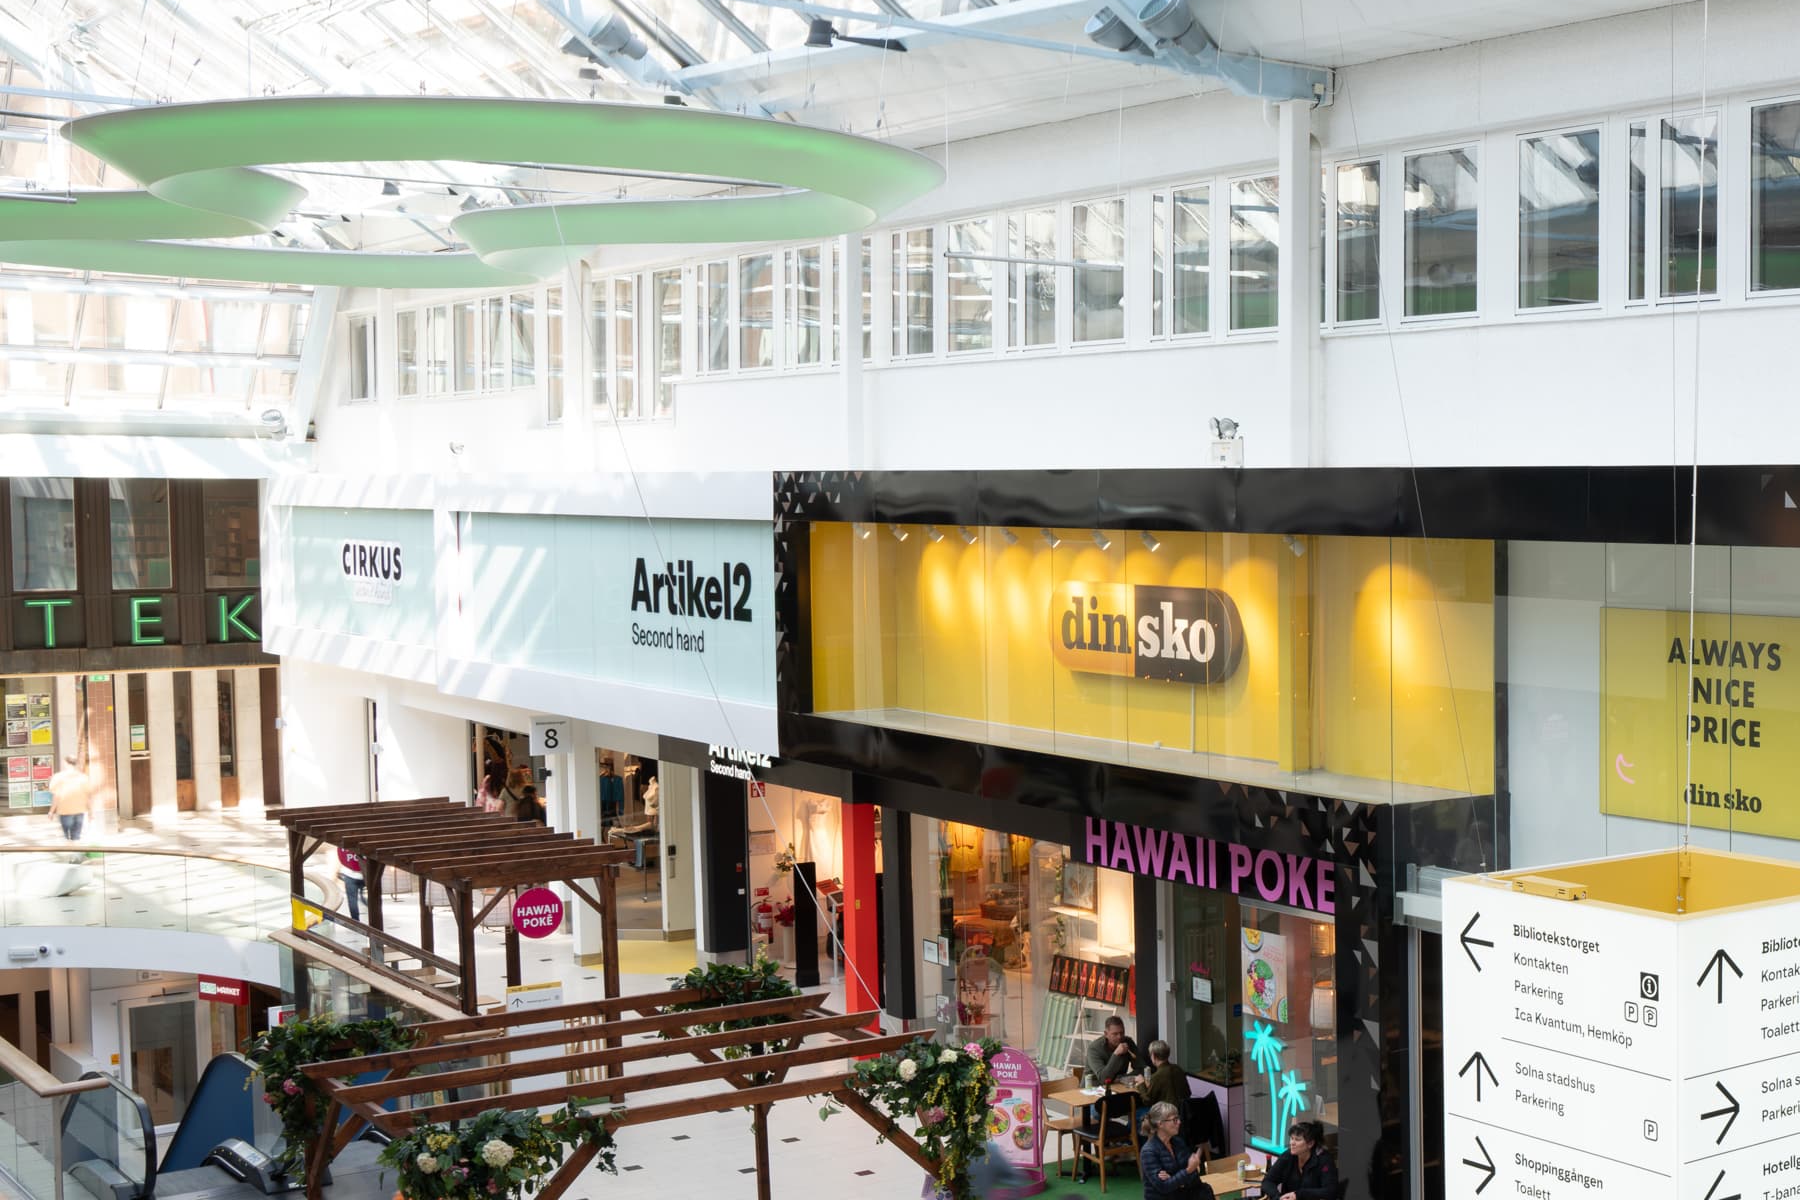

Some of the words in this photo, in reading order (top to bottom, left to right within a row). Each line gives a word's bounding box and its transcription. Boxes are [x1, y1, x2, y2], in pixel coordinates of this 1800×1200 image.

[342, 543, 402, 581] CIRKUS
[631, 557, 752, 622] Artikel2
[24, 595, 262, 648] TEK
[1061, 596, 1132, 654] din
[1137, 601, 1216, 663] sko
[631, 623, 673, 649] Second
[676, 627, 705, 653] hand
[1668, 637, 1782, 671] ALWAYS
[1692, 677, 1755, 709] NICE
[544, 728, 559, 749] 8
[1686, 714, 1761, 748] PRICE
[710, 760, 735, 777] Second
[735, 765, 751, 780] hand
[1684, 783, 1721, 808] din
[1724, 788, 1762, 813] sko
[1086, 816, 1217, 890] HAWAII
[517, 904, 559, 917] HAWAII
[1513, 924, 1600, 954] Bibliotekstorget
[1513, 952, 1569, 975] Kontakten
[1514, 979, 1564, 1006] Parkering
[1515, 1007, 1532, 1022] Ica
[1535, 1013, 1585, 1038] Kvantum,
[1587, 1024, 1633, 1048] Hemköp
[1760, 1020, 1800, 1039] Toalett
[993, 1062, 1022, 1070] HAWAII
[1515, 1062, 1544, 1080] Solna
[1546, 1071, 1596, 1094] stadshus
[1761, 1076, 1792, 1094] Solna
[1515, 1089, 1565, 1116] Parkering
[1515, 1152, 1604, 1189] Shoppinggången
[1515, 1179, 1551, 1200] Toalett
